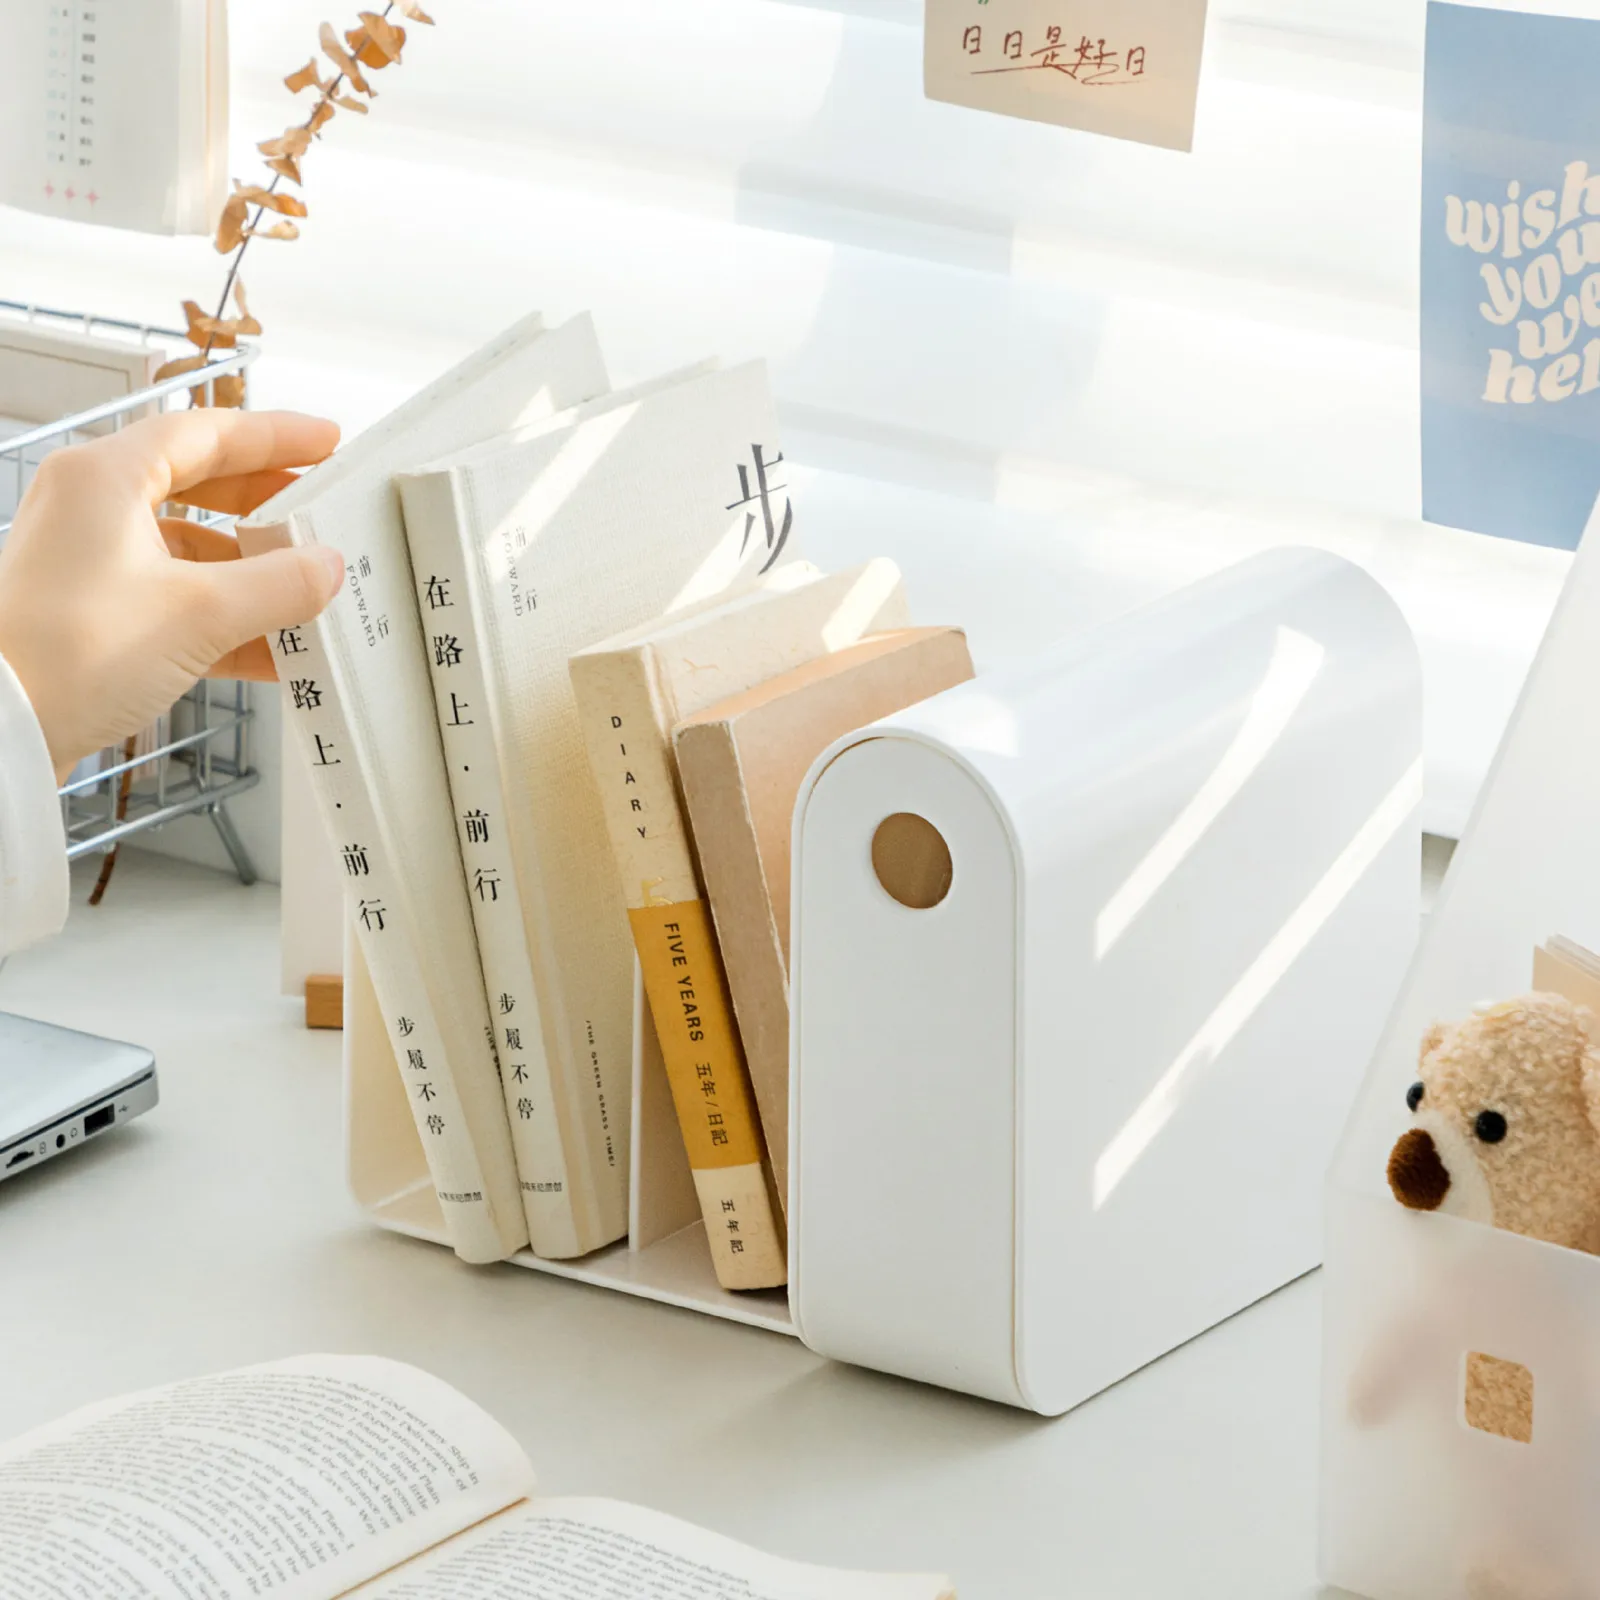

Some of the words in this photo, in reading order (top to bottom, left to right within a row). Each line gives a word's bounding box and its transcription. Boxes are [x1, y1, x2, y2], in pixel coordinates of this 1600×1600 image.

[962, 25, 1146, 79] 日日是好日
[1444, 160, 1600, 259] wish
[725, 443, 793, 576] 步
[346, 565, 376, 648] FORWARD
[501, 532, 525, 617] FORWARD
[611, 715, 647, 838] DIARY
[664, 922, 688, 967] FIVE
[676, 975, 704, 1043] YEARS
[396, 1016, 446, 1136] 步履不停
[497, 992, 536, 1120] 步履不停
[721, 1199, 744, 1254] 五年記
